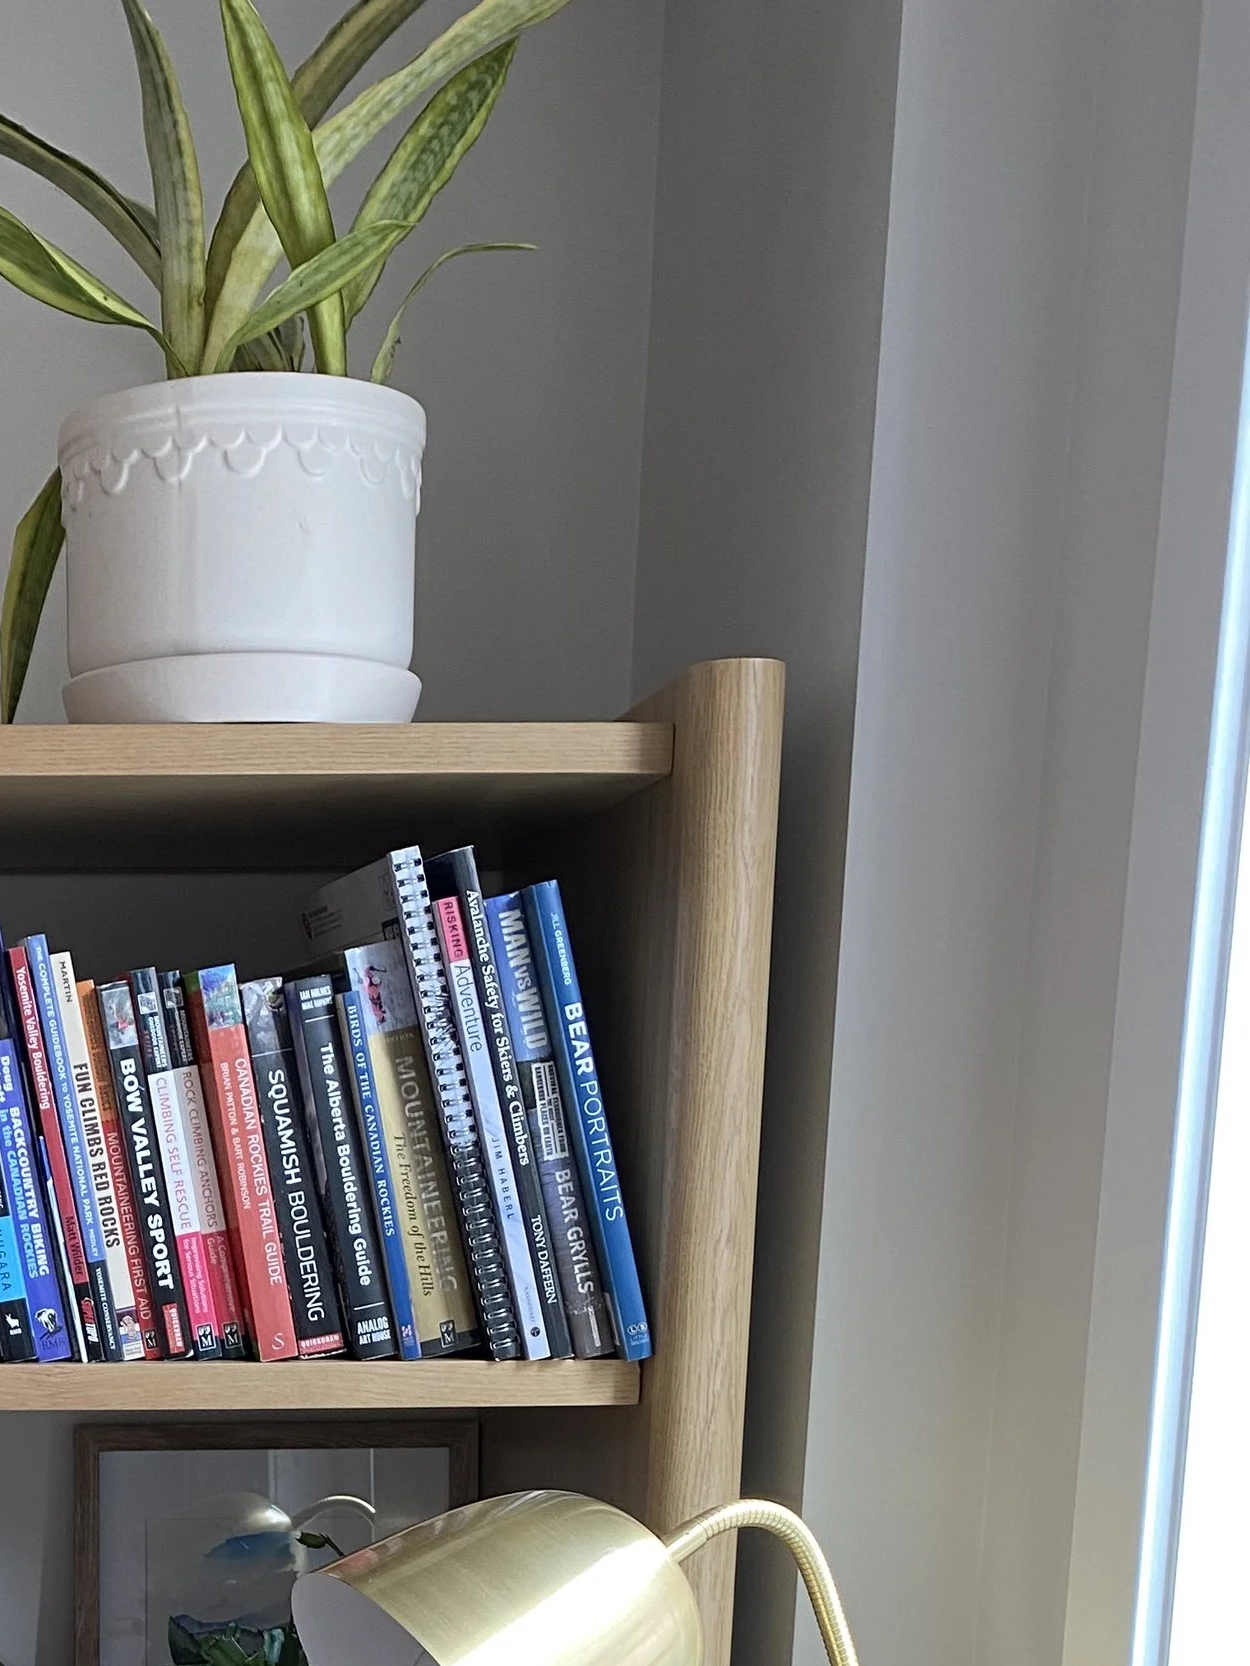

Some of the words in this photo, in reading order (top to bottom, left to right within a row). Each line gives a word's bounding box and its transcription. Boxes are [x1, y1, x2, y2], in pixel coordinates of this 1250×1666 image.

[466, 890, 492, 963] Avalanche
[550, 912, 559, 930] JILL
[59, 961, 73, 1003] MARTIN
[443, 901, 463, 958] RISKING
[454, 965, 484, 1053] Adventure
[554, 930, 572, 986] GREENBERG
[15, 966, 32, 1016] Yosemite
[481, 964, 500, 1010] Safety
[24, 1017, 40, 1050] Valley
[347, 1005, 363, 1048] BIRDS
[491, 1013, 505, 1034] for
[31, 1052, 51, 1110] Bouldering
[73, 1063, 91, 1094] FUN
[319, 1043, 334, 1075] The
[355, 1052, 366, 1069] OF
[495, 1036, 515, 1082] Skiers
[155, 1077, 175, 1144] CLIMBING
[234, 1058, 255, 1130] CANADIAN
[325, 1079, 346, 1141] Alberta
[361, 1072, 371, 1100] THE
[507, 1084, 518, 1099] &
[79, 1097, 104, 1158] CLIMBS
[509, 1100, 530, 1166] Climbers
[564, 1002, 594, 1076] BEAR
[579, 1080, 624, 1222] PORTRAITS
[166, 1147, 181, 1176] SELF
[182, 1071, 196, 1104] ROCK
[189, 1109, 208, 1167] CLIMBING
[200, 1170, 217, 1228] ANCHORS
[364, 1104, 385, 1175] CANADIAN
[393, 1132, 407, 1160] The
[92, 1163, 111, 1192] RED
[119, 1058, 143, 1113] BOW
[131, 1116, 160, 1208] VALLEY
[147, 1214, 175, 1290] SPORT
[248, 1134, 267, 1196] ROCKIES
[337, 1144, 362, 1235] Bouldering
[491, 1136, 503, 1160] JIM
[498, 1168, 515, 1220] HABERL
[9, 1107, 40, 1219] BACKCOUNTRY
[30, 1223, 50, 1277] BIKING
[173, 1180, 191, 1230] RESCUE
[267, 1069, 302, 1185] SQUAMISH
[288, 1191, 325, 1322] BOULDERING
[377, 1179, 395, 1237] ROCKIES
[398, 1163, 418, 1221] Freedom
[88, 1229, 99, 1258] MEDLEY
[98, 1196, 120, 1249] ROCKS
[106, 1132, 140, 1255] MOUNTAINEERING
[129, 1258, 146, 1295] FIRST
[139, 1297, 151, 1320] AID
[258, 1200, 276, 1240] TRAIL
[410, 1225, 425, 1239] of
[531, 1214, 546, 1250] TONY
[554, 1168, 578, 1224] BEAR
[567, 1226, 594, 1294] GRYLLS
[207, 1238, 217, 1265] Guide
[264, 1242, 282, 1286] GUIDE
[353, 1238, 373, 1287] Guide
[415, 1241, 428, 1262] the
[418, 1264, 434, 1296] Hills
[538, 1251, 557, 1304] DAFFERN
[94, 1267, 107, 1302] YOSEMITE
[102, 1302, 115, 1350] CONSERVANCY
